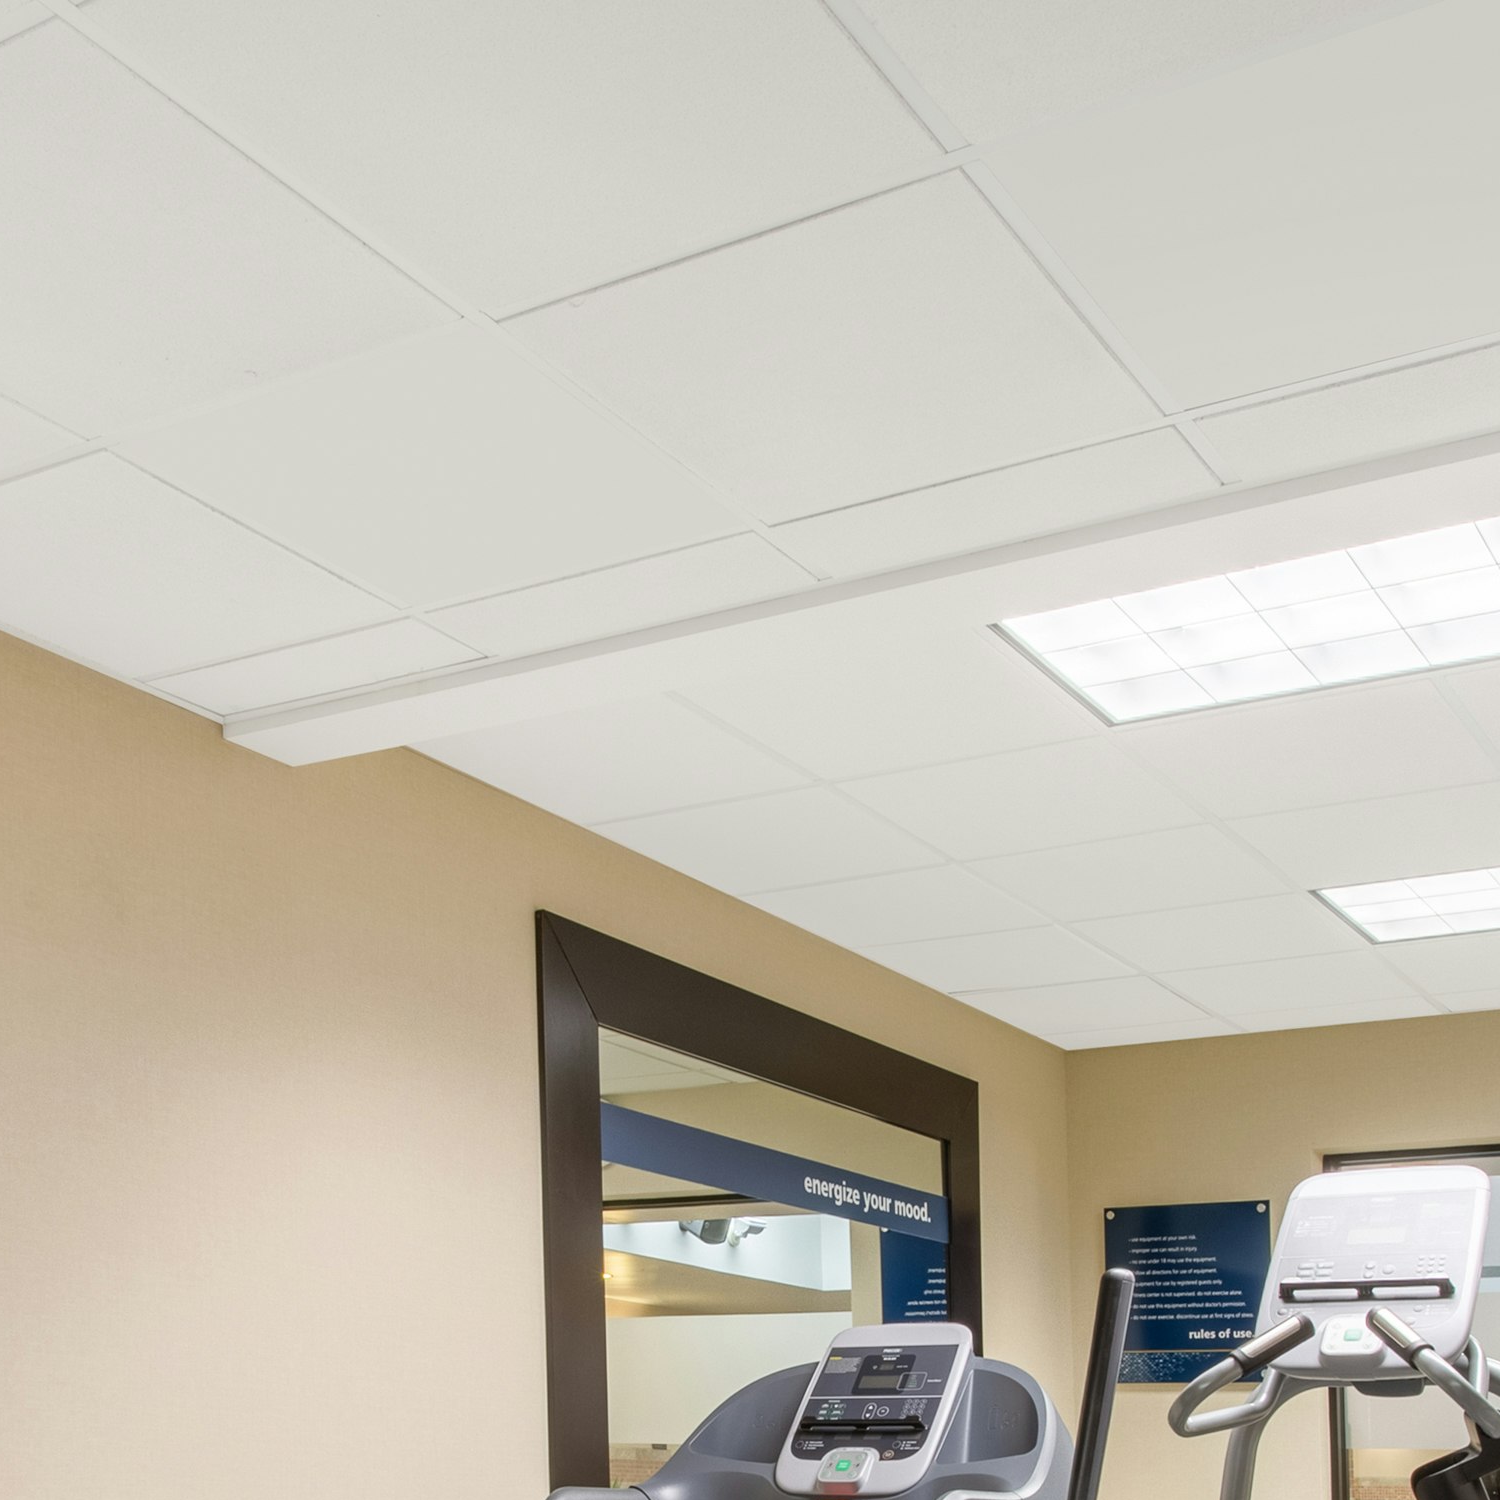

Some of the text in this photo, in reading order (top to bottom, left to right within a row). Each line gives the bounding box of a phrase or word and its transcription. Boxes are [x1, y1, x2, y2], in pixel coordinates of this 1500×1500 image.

[804, 1176, 931, 1223] energize your mood.
[1188, 1328, 1216, 1339] rules
[1218, 1328, 1231, 1338] of
